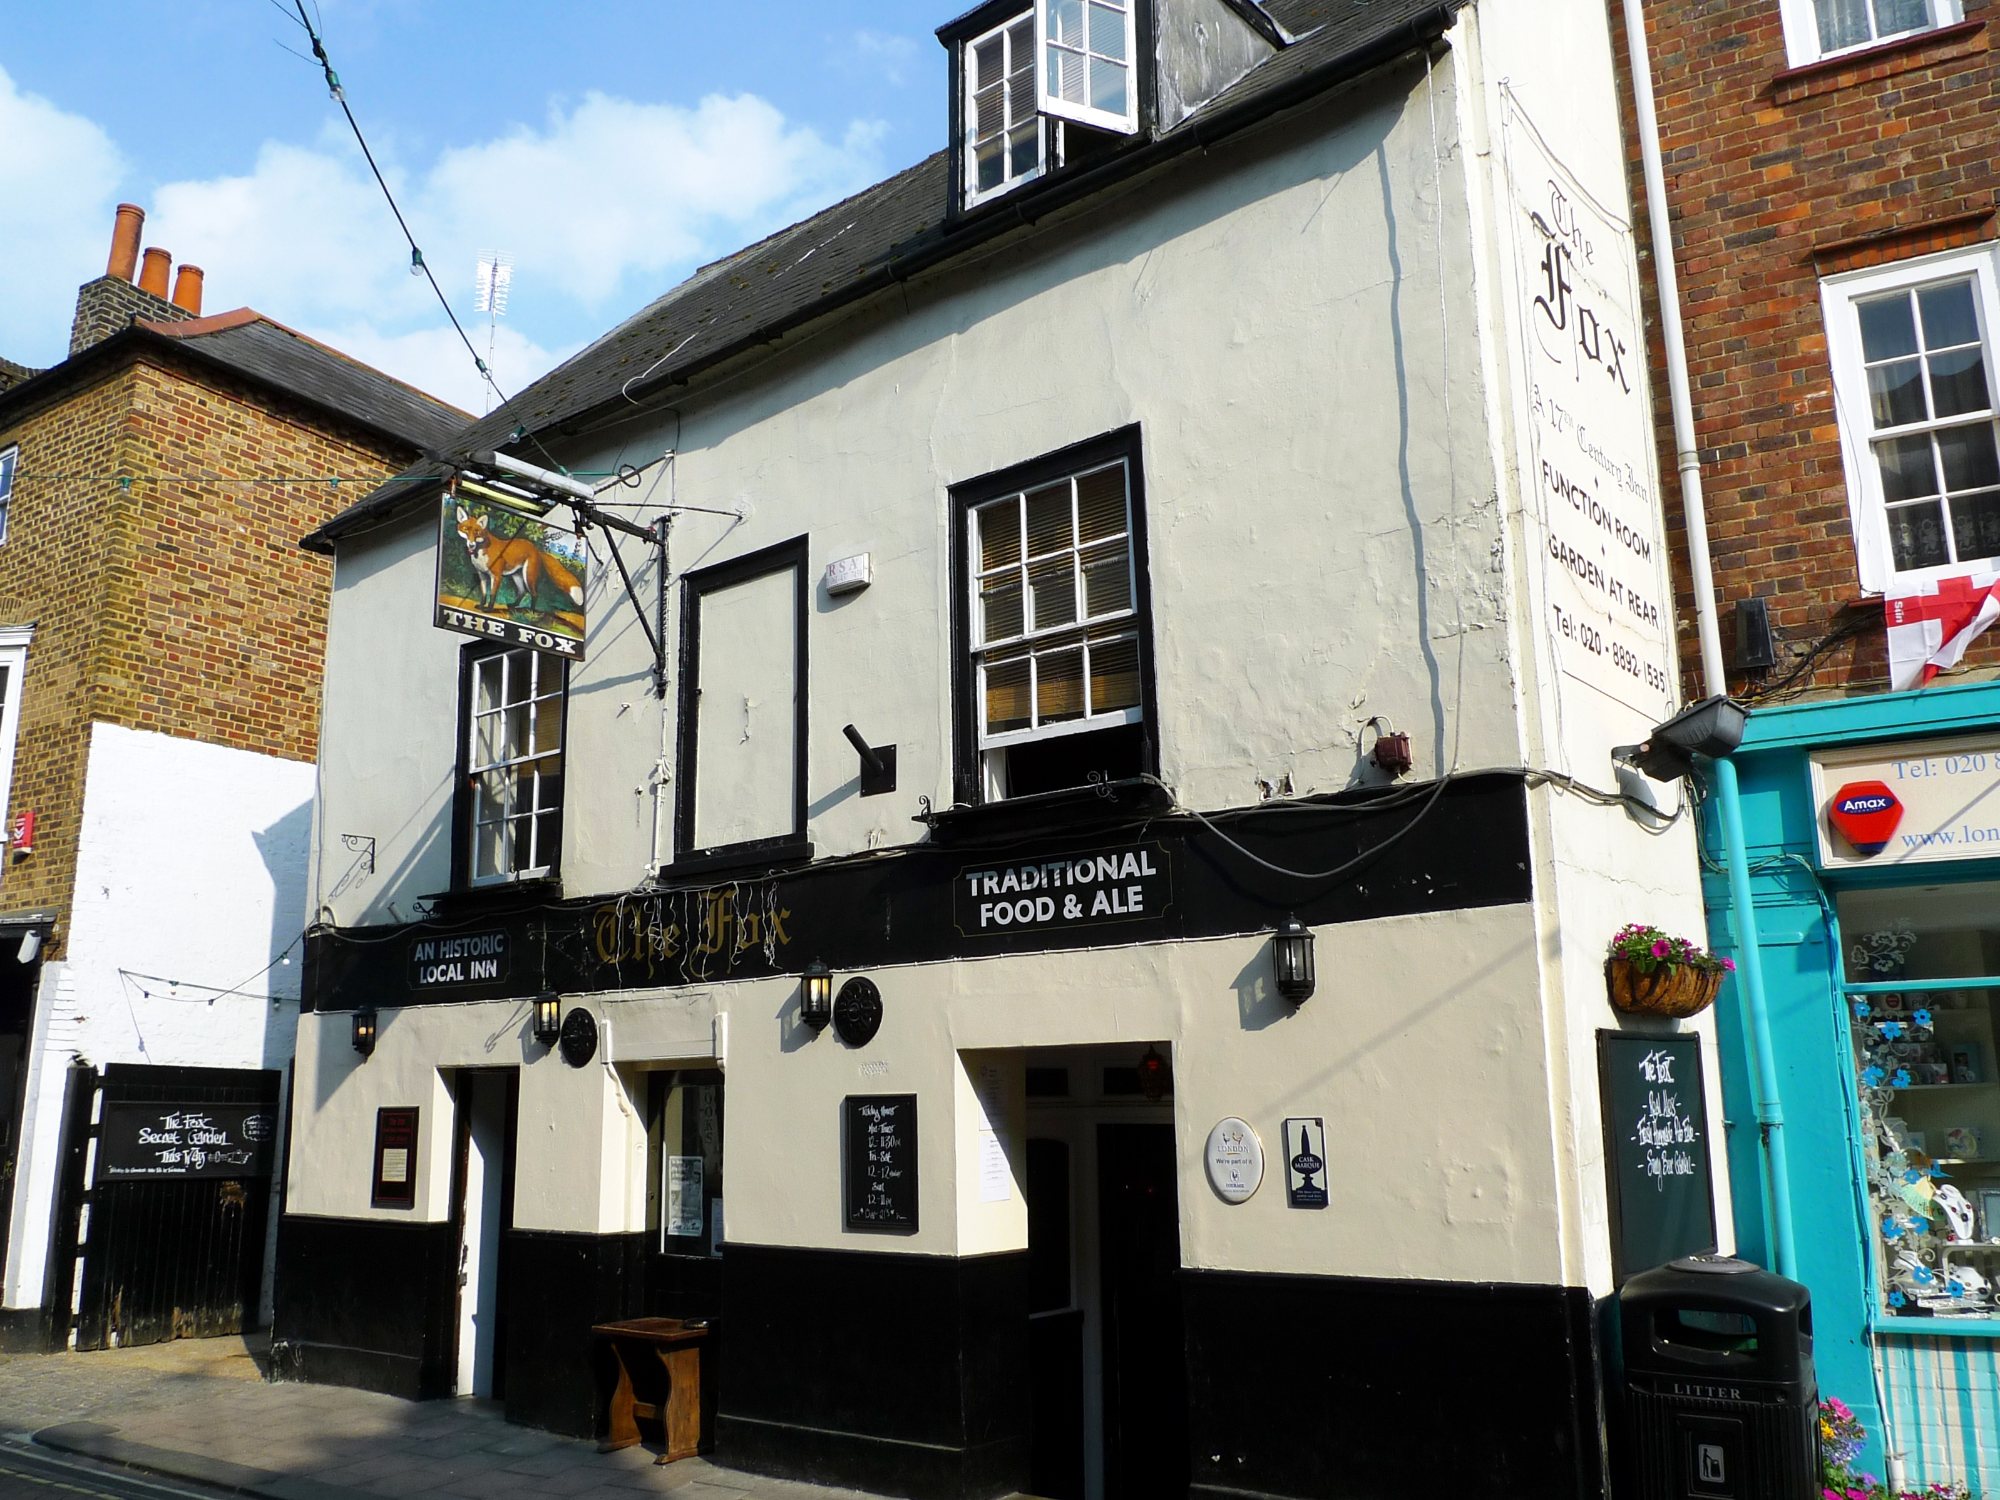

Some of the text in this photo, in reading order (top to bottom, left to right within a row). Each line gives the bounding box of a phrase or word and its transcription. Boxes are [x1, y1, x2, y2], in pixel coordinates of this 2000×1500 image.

[1548, 180, 1594, 268] The
[1531, 210, 1631, 395] Fox
[1576, 423, 1624, 491] Century
[1542, 458, 1652, 564] FUNCTION ROOM
[1548, 532, 1660, 630] GARDEN AT REAR
[443, 609, 578, 655] THE FOX
[1552, 603, 1578, 642] Tel:
[1580, 622, 1602, 656] 020
[1612, 641, 1640, 679] 8892
[1643, 660, 1666, 694] 1535
[1890, 757, 1937, 780] Tel:
[1944, 754, 1987, 775] 020
[1844, 798, 1887, 811] Amax
[965, 850, 1157, 897] TRADITIONAL
[980, 884, 1145, 928] FOOD & ALE
[414, 934, 505, 962] AN HISTORIC
[592, 887, 793, 980] The Fox
[420, 958, 497, 984] LOCAL INN
[138, 1127, 183, 1145] Secret
[187, 1128, 234, 1146] Garden
[159, 1111, 218, 1130] The Fox
[155, 1147, 182, 1164] This
[182, 1147, 208, 1170] Way
[1217, 1145, 1249, 1154] LONDON
[1674, 1383, 1741, 1400] LITTER
